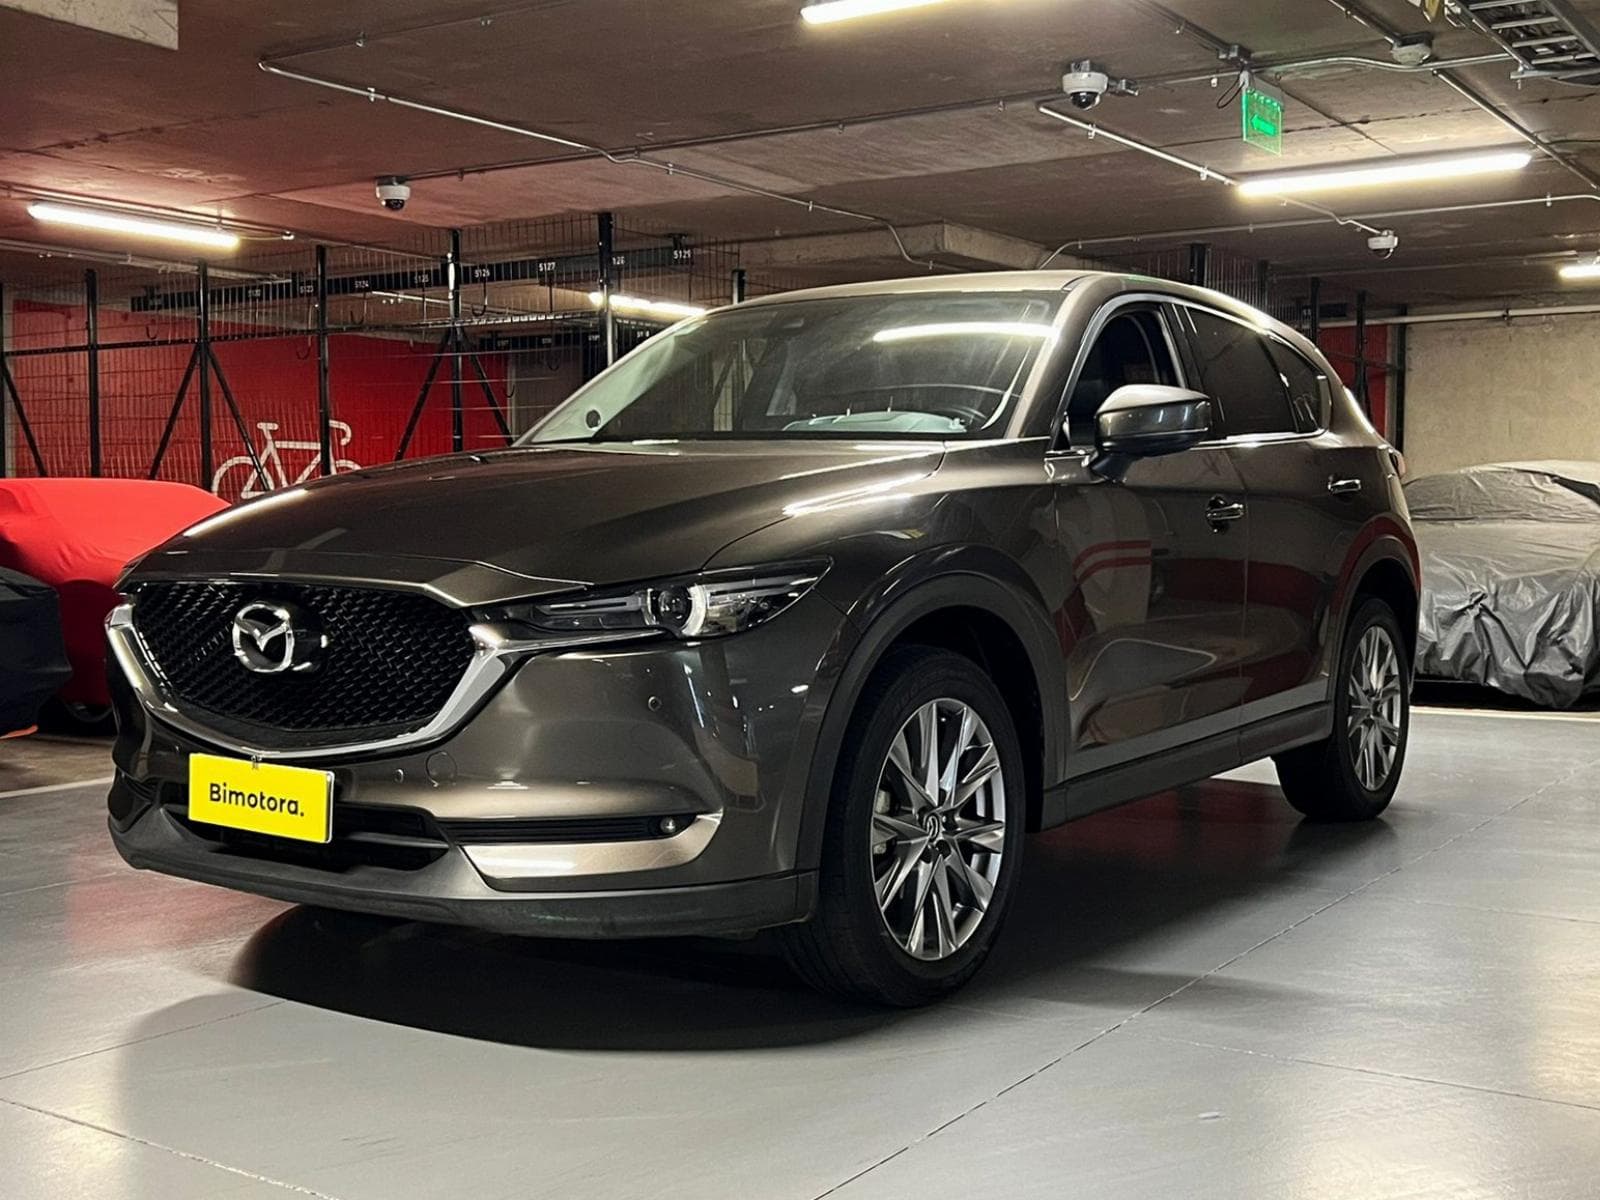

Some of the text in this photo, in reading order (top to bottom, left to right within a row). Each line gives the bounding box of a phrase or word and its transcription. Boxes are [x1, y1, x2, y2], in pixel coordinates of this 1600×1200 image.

[539, 262, 556, 272] S127
[474, 269, 490, 278] S126
[209, 781, 305, 817] Bimotora.
